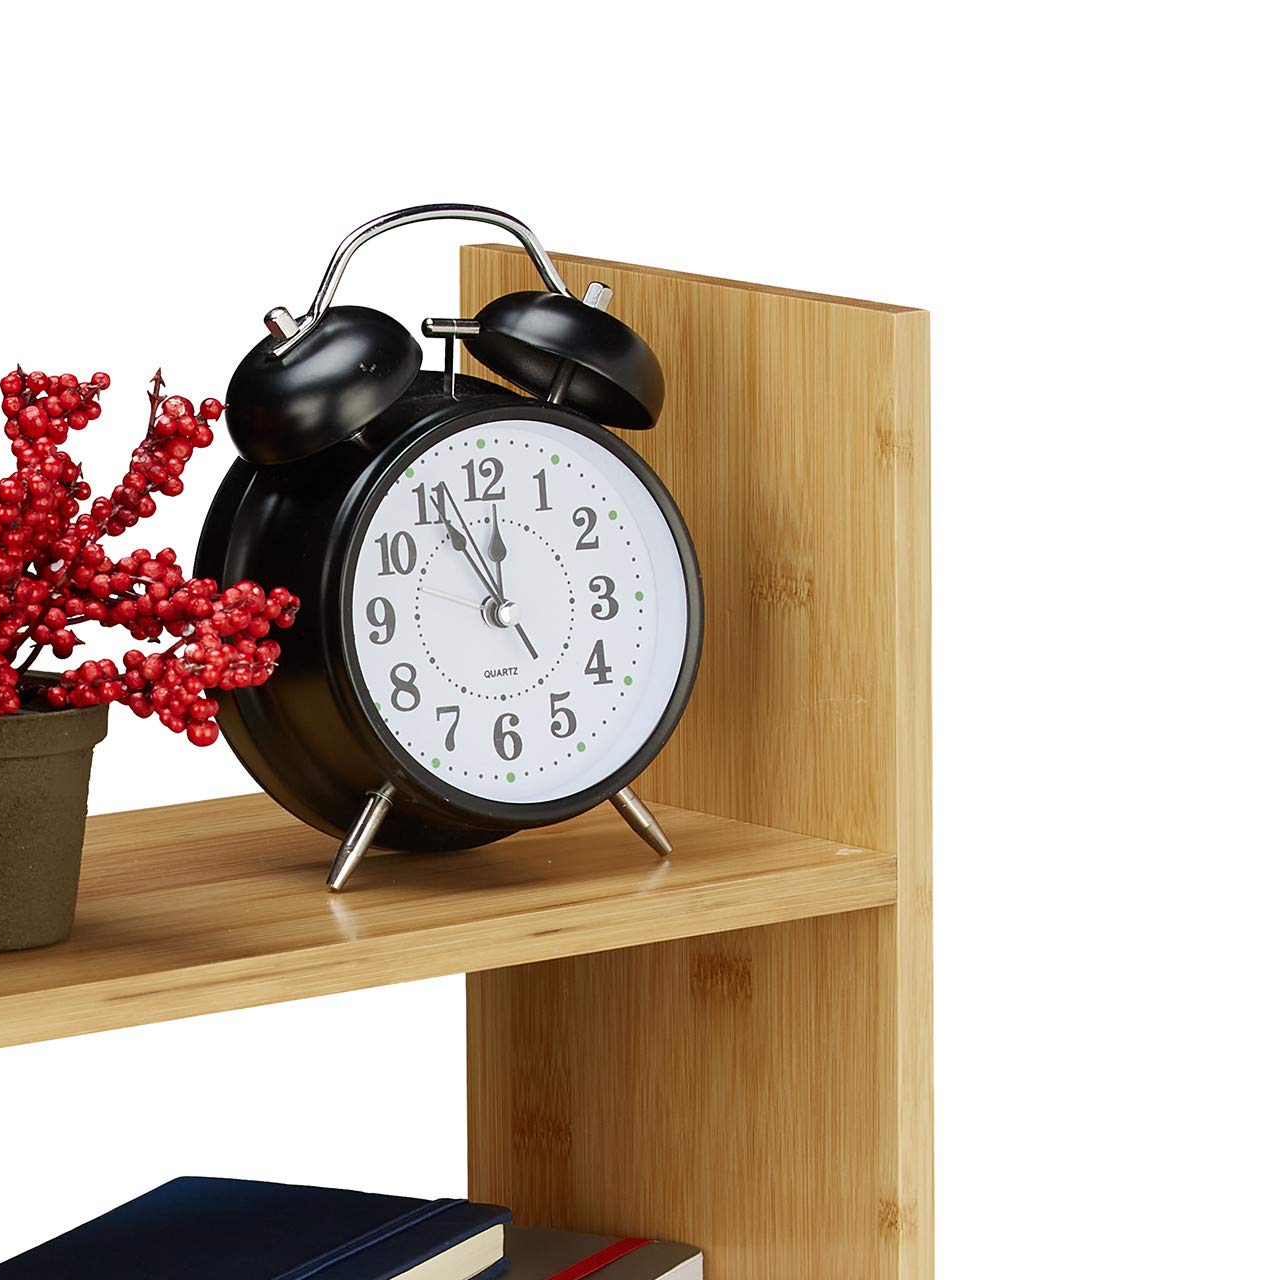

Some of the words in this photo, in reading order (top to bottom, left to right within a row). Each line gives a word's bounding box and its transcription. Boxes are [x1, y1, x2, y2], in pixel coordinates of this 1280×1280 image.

[461, 457, 506, 502] 12
[533, 469, 553, 511] 1
[411, 482, 452, 526] 11
[572, 507, 600, 550] 2
[374, 530, 418, 576] 10
[589, 575, 620, 620] 3
[366, 597, 396, 645] 9
[483, 666, 519, 679] QUARTZ
[584, 639, 613, 685] 4
[390, 662, 421, 711] 8
[436, 705, 462, 752] 7
[493, 713, 523, 761] 6
[549, 691, 577, 738] 5
